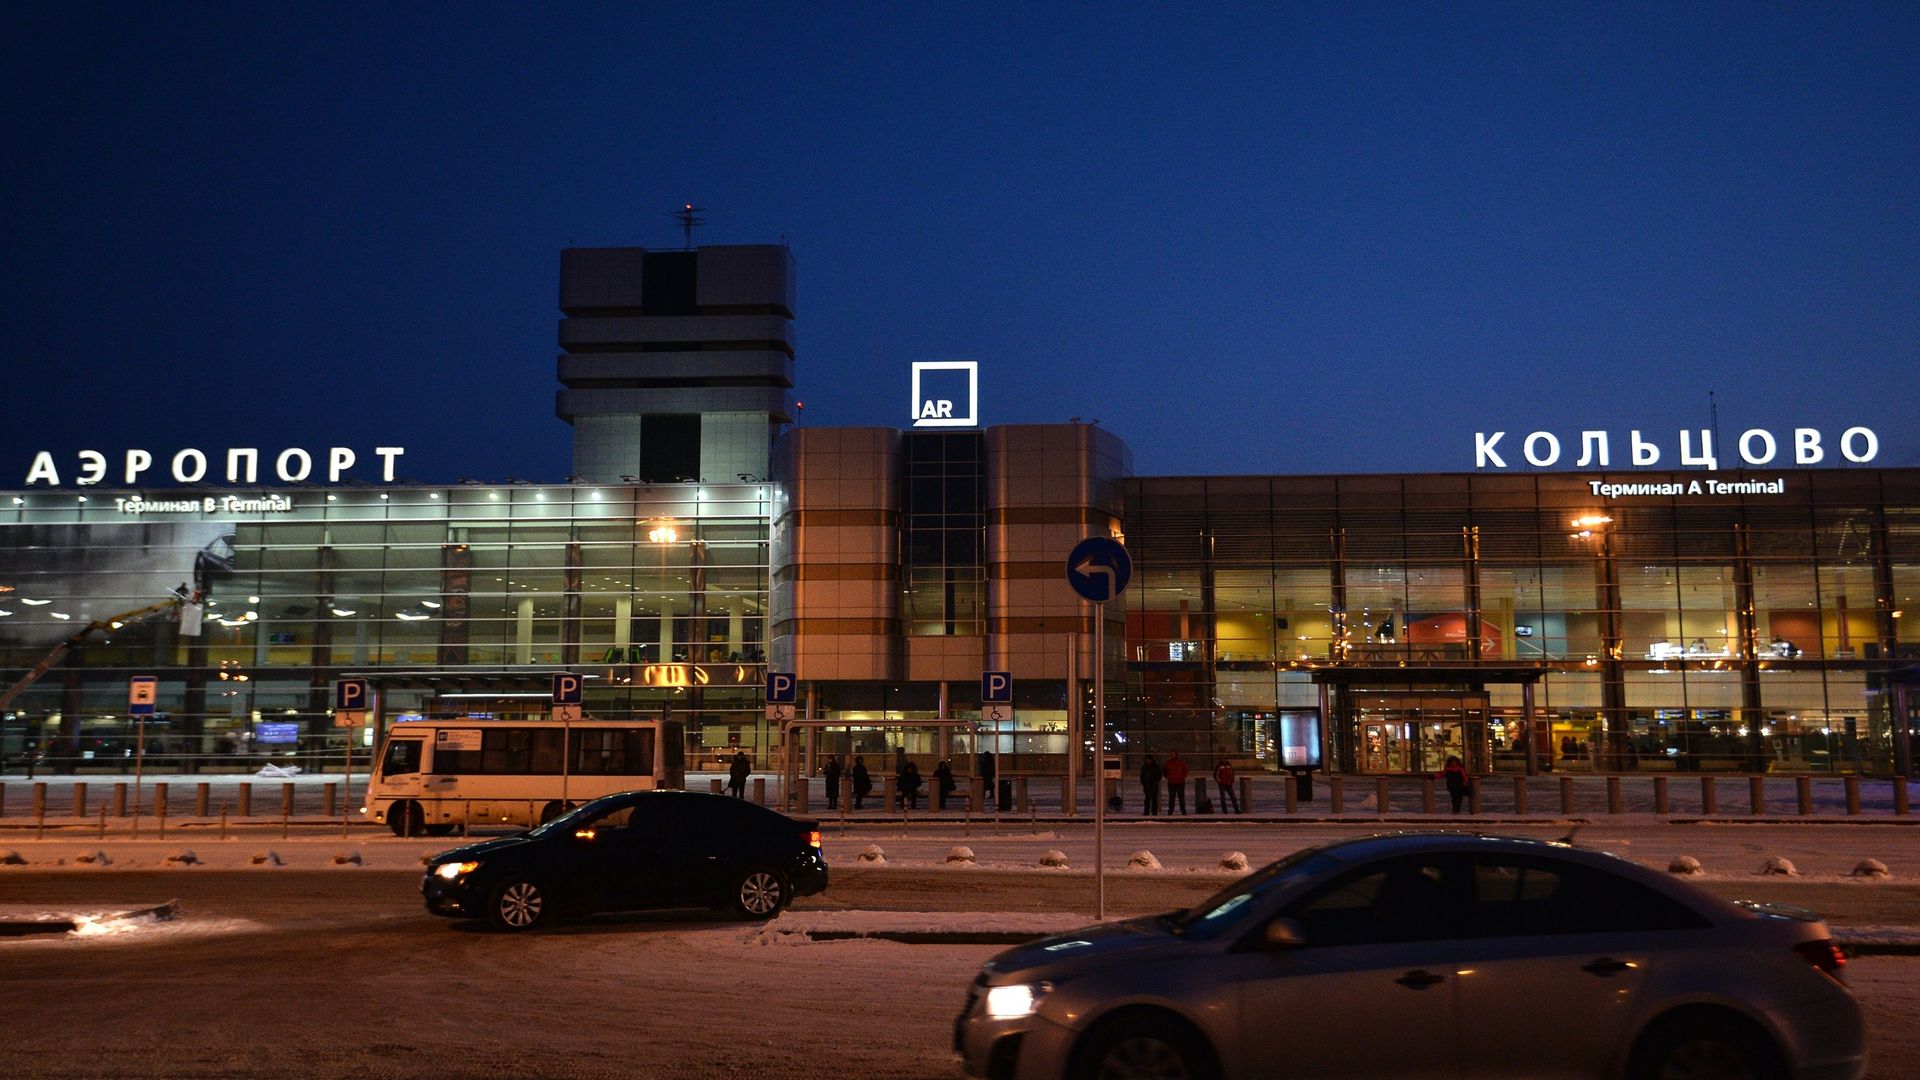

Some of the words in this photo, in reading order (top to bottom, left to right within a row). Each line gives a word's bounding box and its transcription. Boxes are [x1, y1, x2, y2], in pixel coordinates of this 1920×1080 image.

[921, 400, 952, 418] AR
[1475, 426, 1879, 471] КОЛЬЦОВО
[26, 447, 405, 486] АЭРОПОРТ
[1589, 480, 1683, 498] Терминал
[1706, 478, 1785, 495] Terminal
[114, 497, 200, 514] Терминал
[221, 495, 291, 512] Terminal
[343, 683, 361, 706] P
[561, 677, 577, 701] P
[773, 675, 791, 699] P
[990, 675, 1006, 699] P
